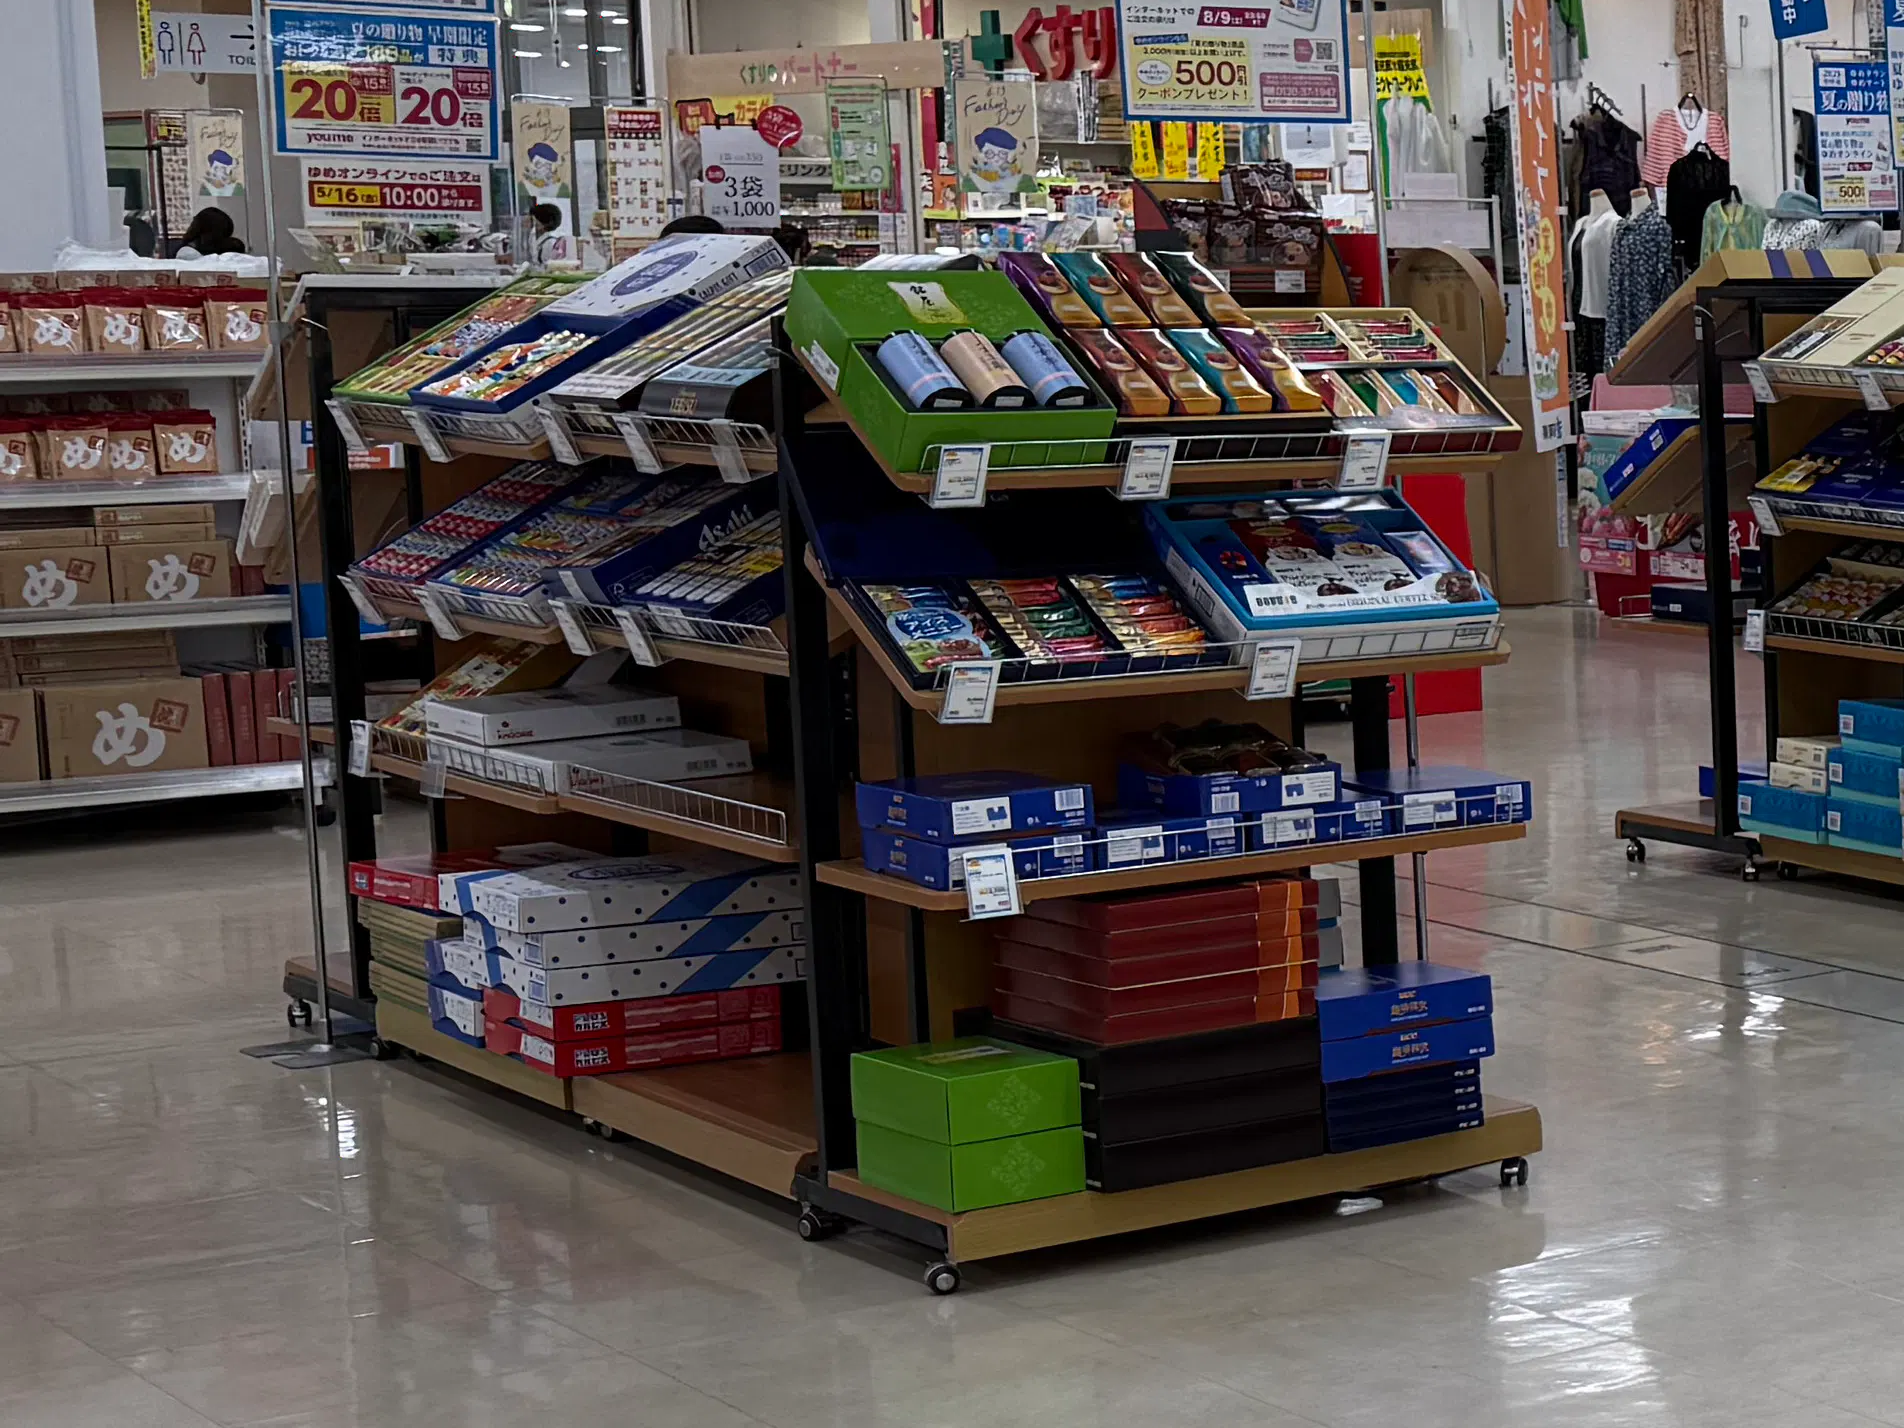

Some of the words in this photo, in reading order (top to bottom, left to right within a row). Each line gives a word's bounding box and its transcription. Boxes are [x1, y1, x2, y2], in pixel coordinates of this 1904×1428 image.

[427, 26, 488, 46] 早期限定
[1014, 4, 1116, 81] くすり
[1176, 60, 1237, 86] 500
[290, 78, 357, 121] 20
[359, 106, 382, 122] 倍
[401, 87, 460, 126] 20
[460, 112, 484, 128] 倍
[308, 166, 481, 183] ゆめオンラインでのご注文は
[724, 176, 763, 198] 3袋
[383, 188, 439, 207] 10:00
[22, 558, 78, 611] め
[145, 554, 200, 603] め
[92, 702, 167, 768] め
